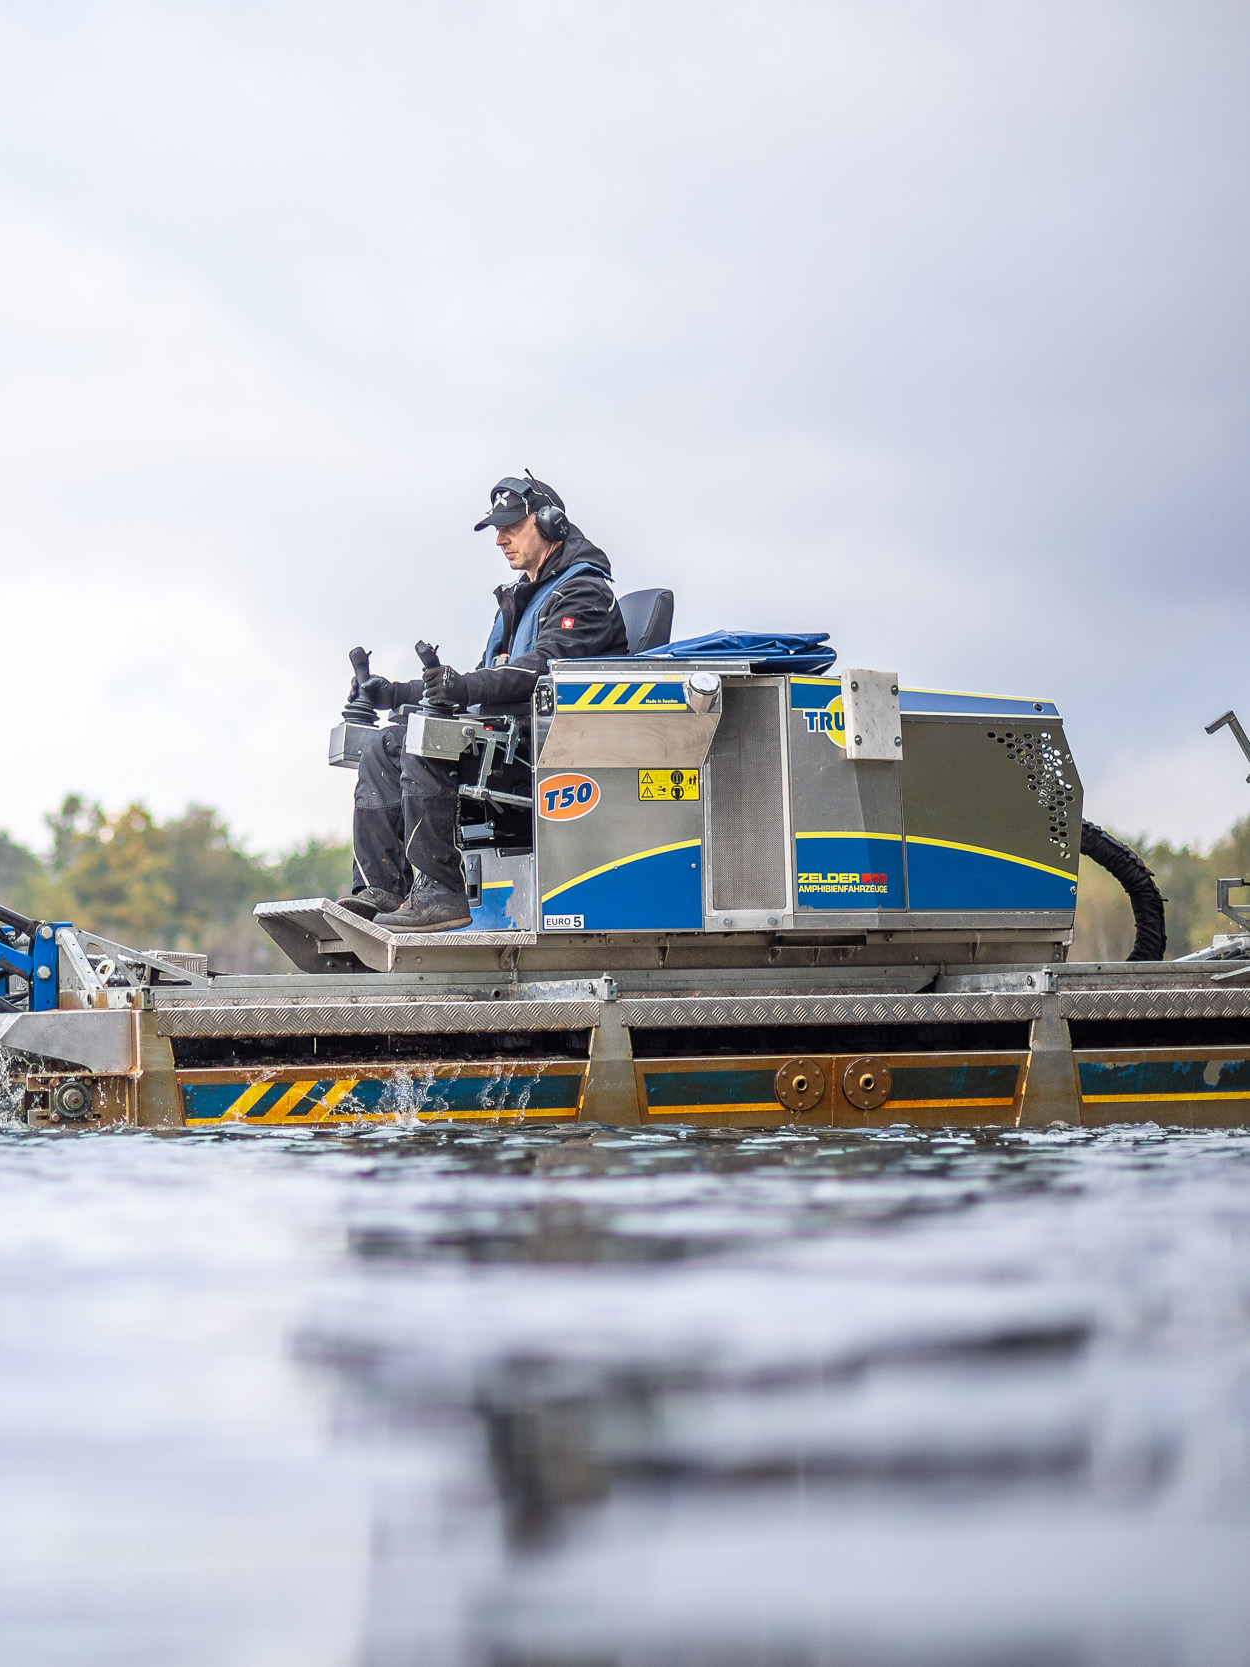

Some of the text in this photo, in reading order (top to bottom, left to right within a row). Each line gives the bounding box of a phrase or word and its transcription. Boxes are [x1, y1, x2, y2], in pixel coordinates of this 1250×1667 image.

[804, 711, 845, 731] TRU
[544, 782, 593, 812] T50
[797, 873, 860, 884] ZELDER
[798, 884, 888, 893] AMPHIBIENFAHRZEUGE
[546, 916, 582, 928] EURO 5
